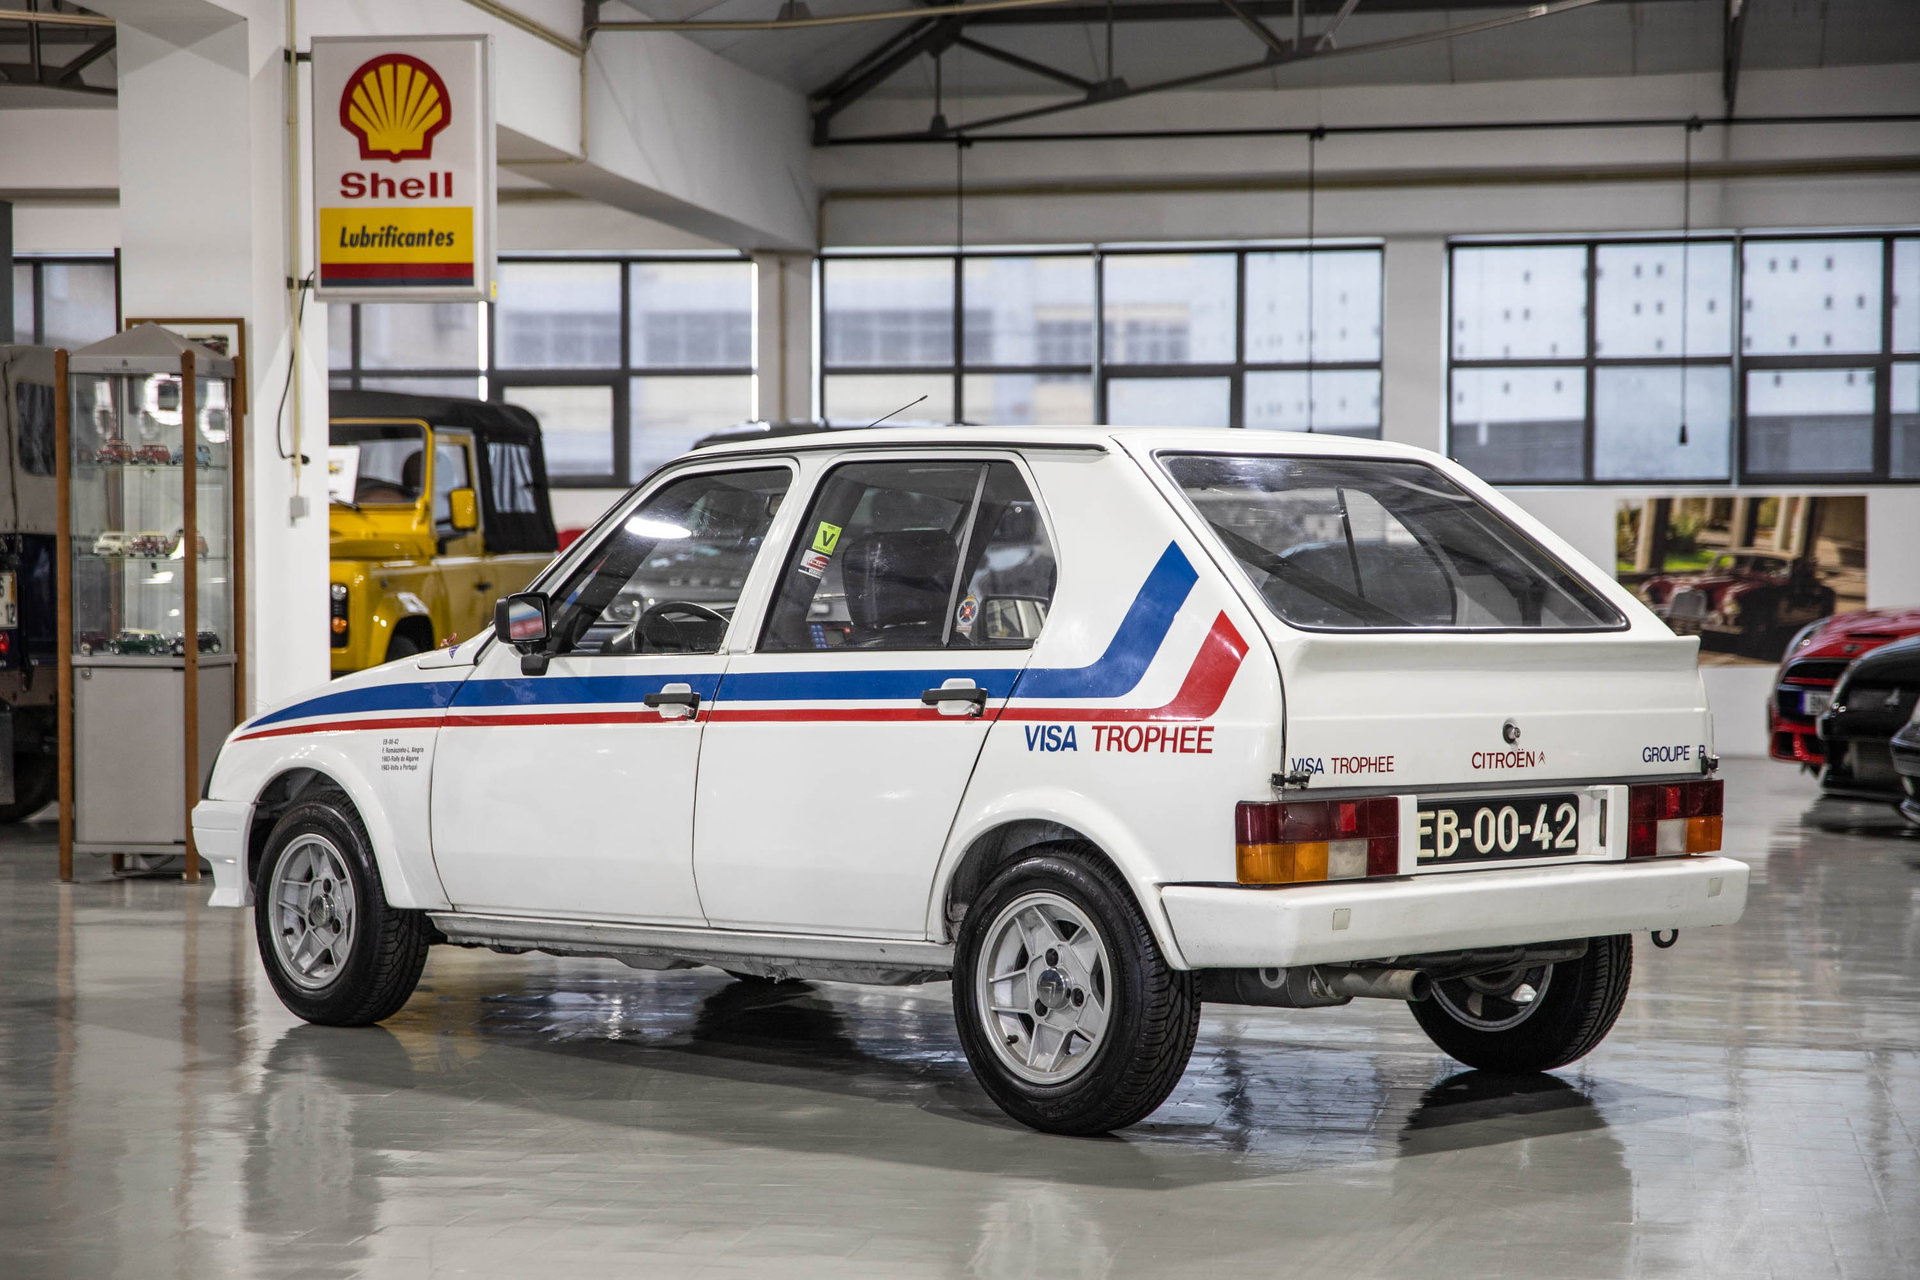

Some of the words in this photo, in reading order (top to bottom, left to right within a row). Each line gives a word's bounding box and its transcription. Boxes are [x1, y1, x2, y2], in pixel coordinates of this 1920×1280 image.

[340, 172, 453, 199] Shell
[339, 225, 454, 248] Lubrificantes
[822, 530, 836, 547] V
[1024, 725, 1078, 752] VISA
[1091, 725, 1215, 754] TROPHEE
[1291, 757, 1325, 775] VISA
[1331, 755, 1395, 775] TROPHEE
[1471, 748, 1536, 770] CITROËN
[1642, 745, 1690, 763] GROUPE
[1417, 802, 1578, 859] EB-00-42
